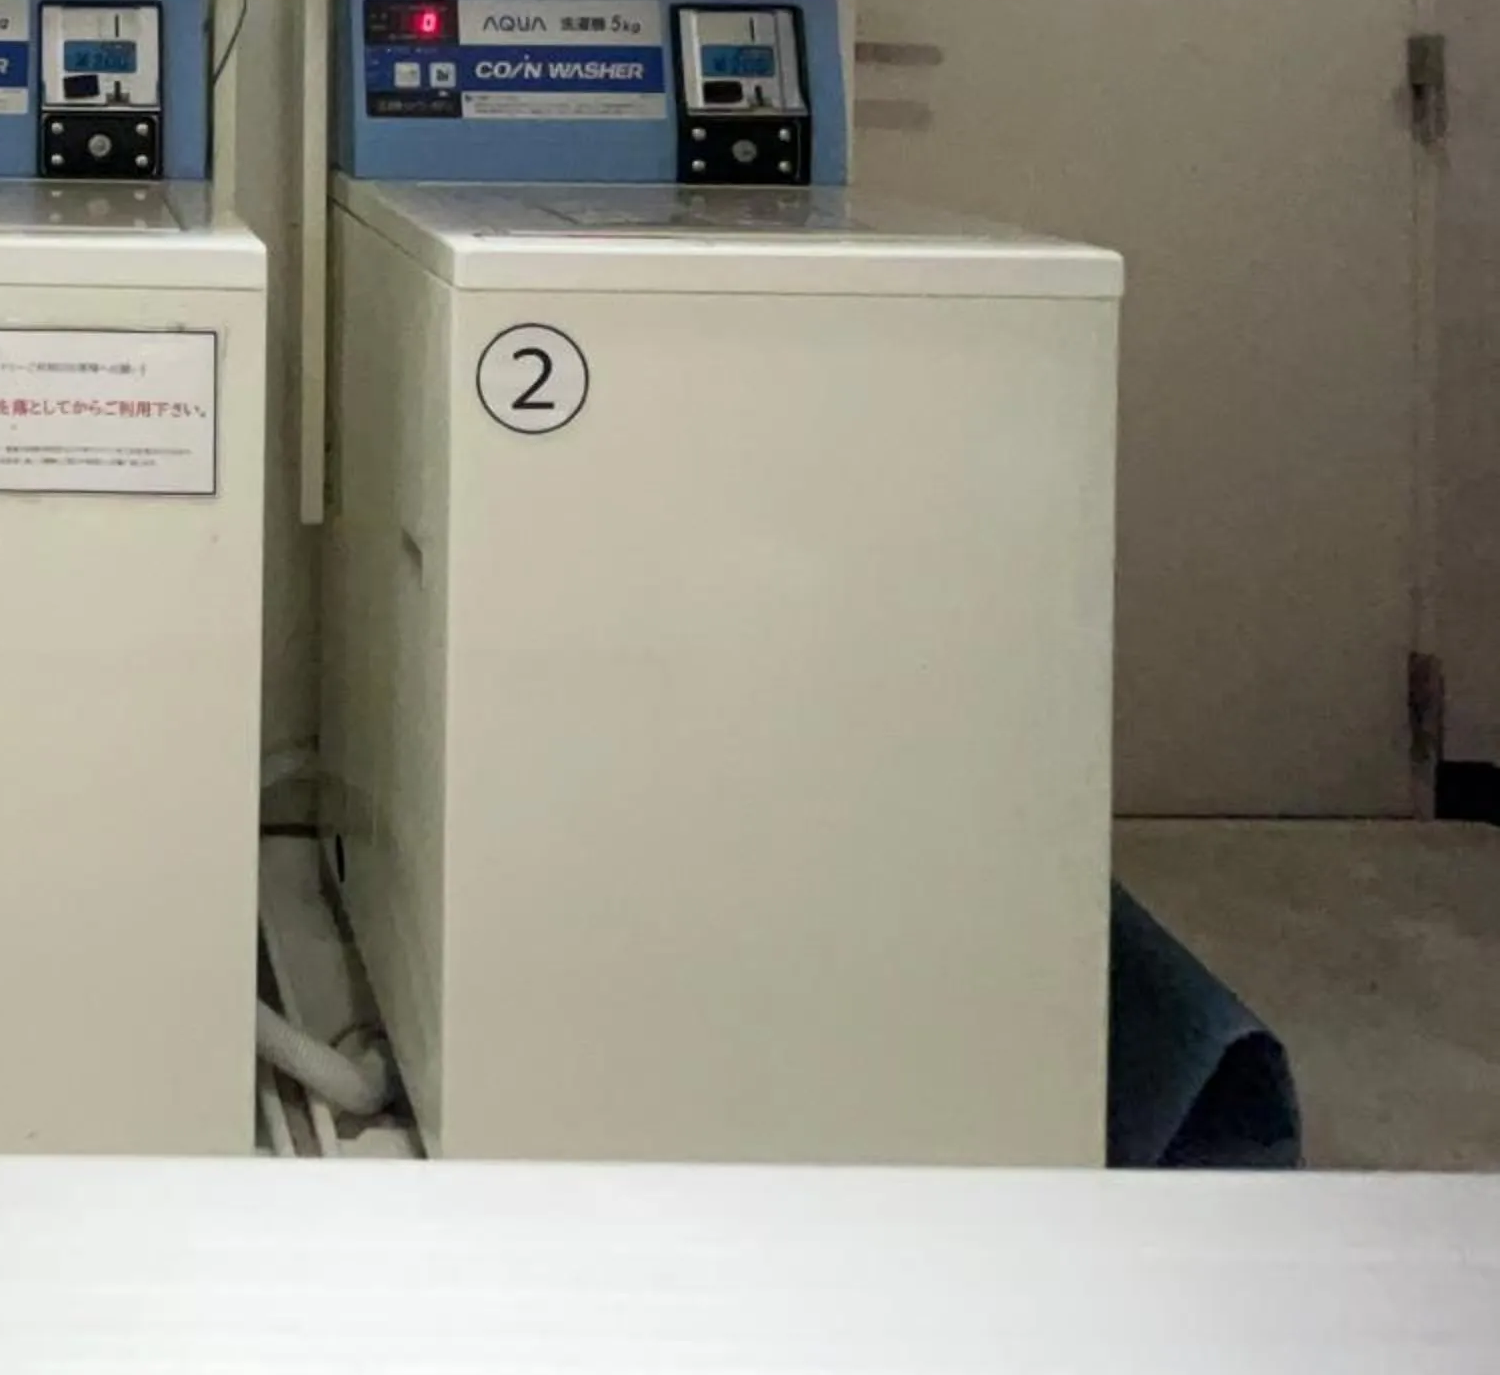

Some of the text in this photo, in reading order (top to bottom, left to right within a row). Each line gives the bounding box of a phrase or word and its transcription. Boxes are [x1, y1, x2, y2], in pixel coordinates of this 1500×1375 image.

[483, 14, 547, 32] AQUA
[610, 14, 641, 34] 5kg
[550, 62, 643, 80] WASHER
